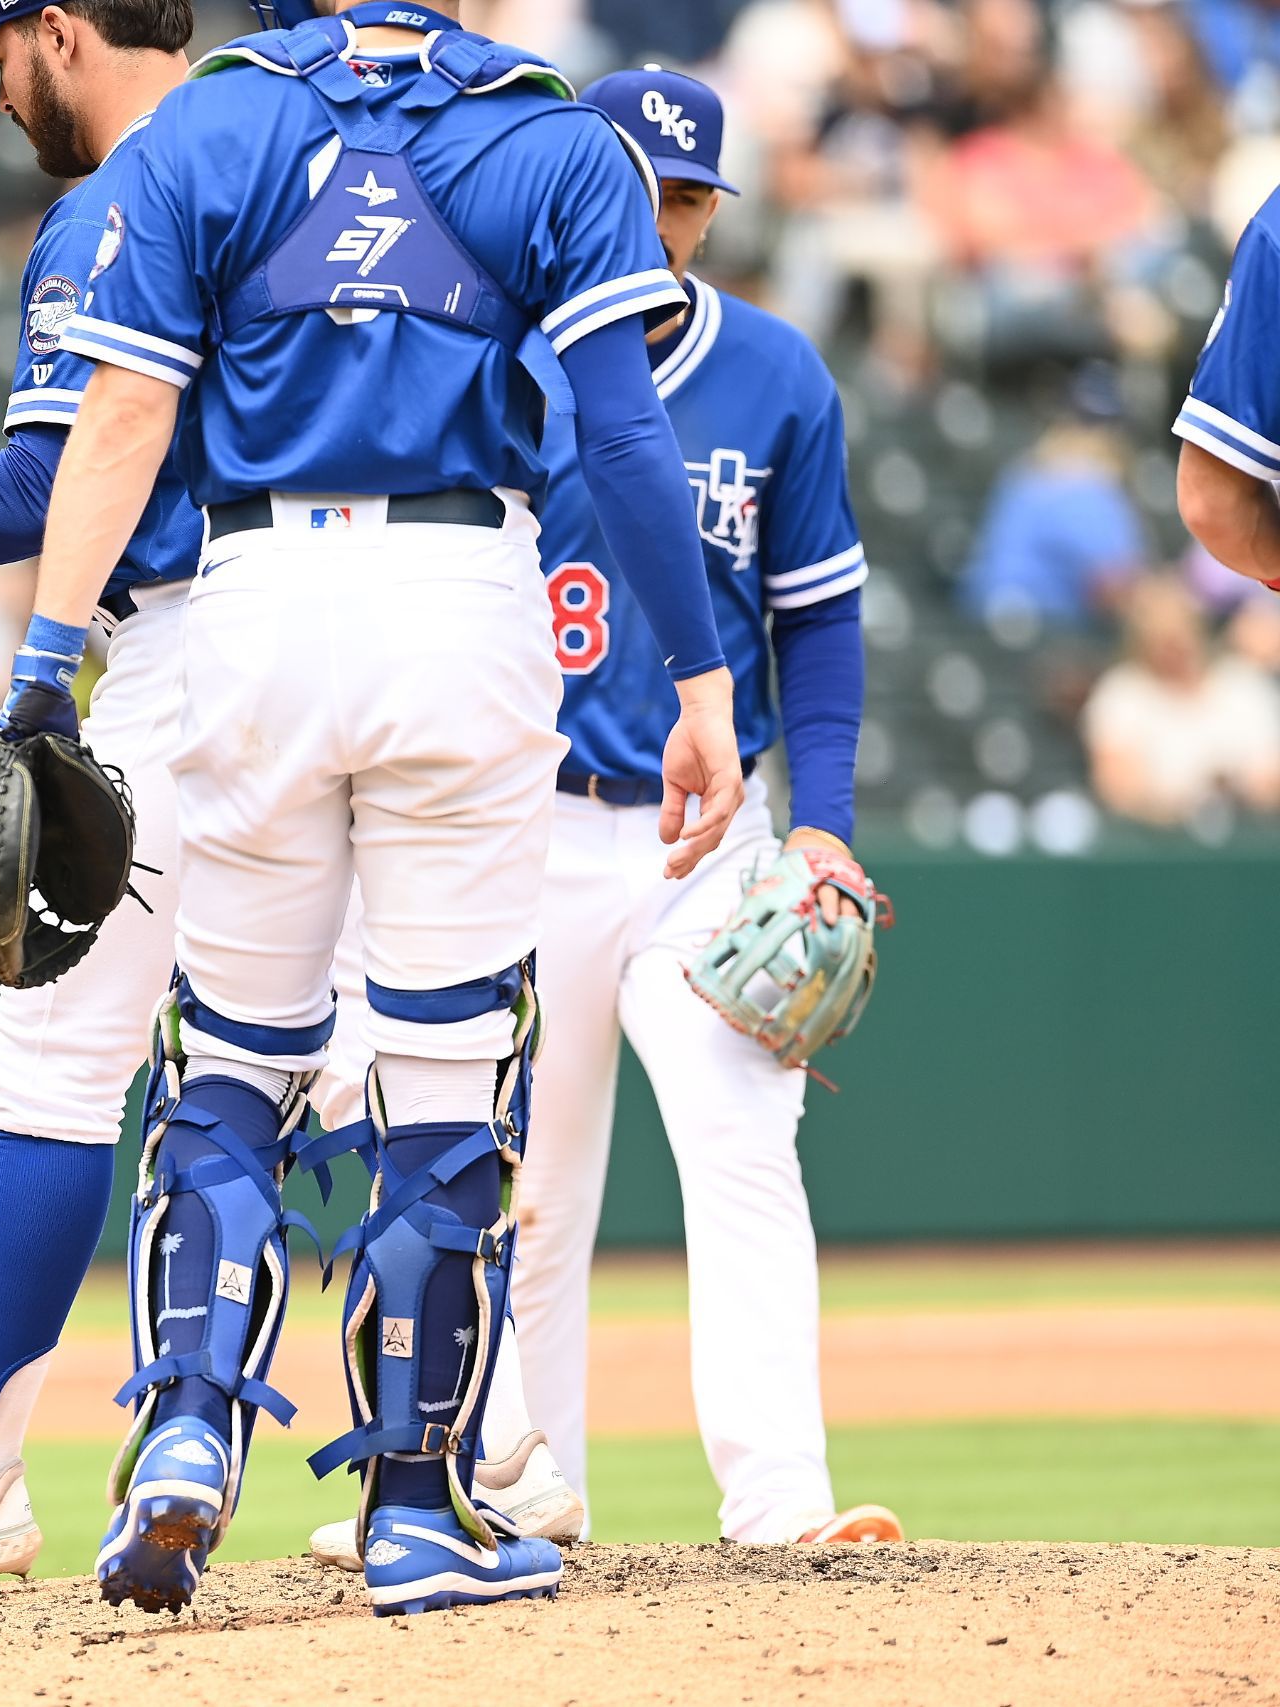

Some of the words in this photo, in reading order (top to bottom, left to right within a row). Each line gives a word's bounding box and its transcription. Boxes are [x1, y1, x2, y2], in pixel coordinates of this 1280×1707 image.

[641, 90, 697, 152] OKC
[33, 279, 62, 303] OKLAHOMA
[61, 280, 77, 297] CITY
[545, 561, 610, 676] 8
